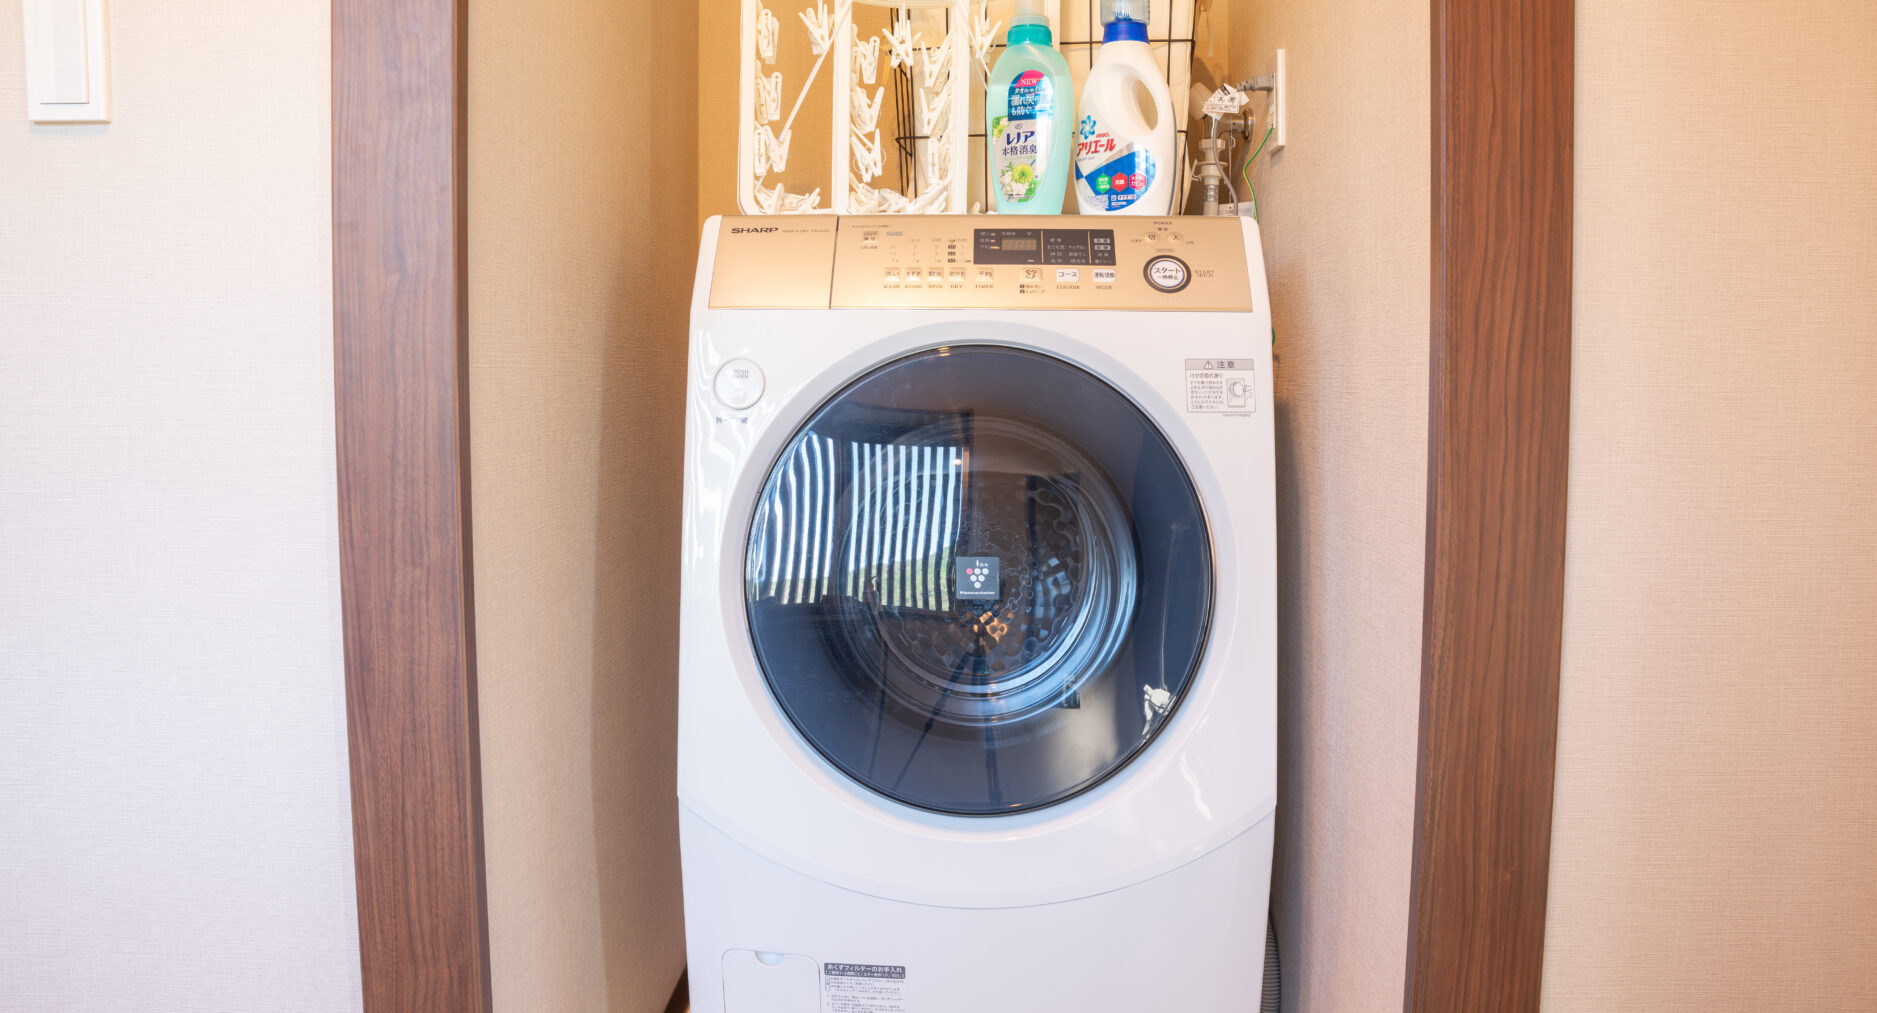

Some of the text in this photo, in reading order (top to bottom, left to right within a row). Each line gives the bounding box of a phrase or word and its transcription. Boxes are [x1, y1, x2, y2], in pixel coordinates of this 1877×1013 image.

[1006, 131, 1036, 145] レノア
[1002, 144, 1037, 157] 本格消臭
[1077, 138, 1116, 157] アリエール
[1154, 267, 1181, 275] スタート
[1217, 361, 1236, 369] 注意
